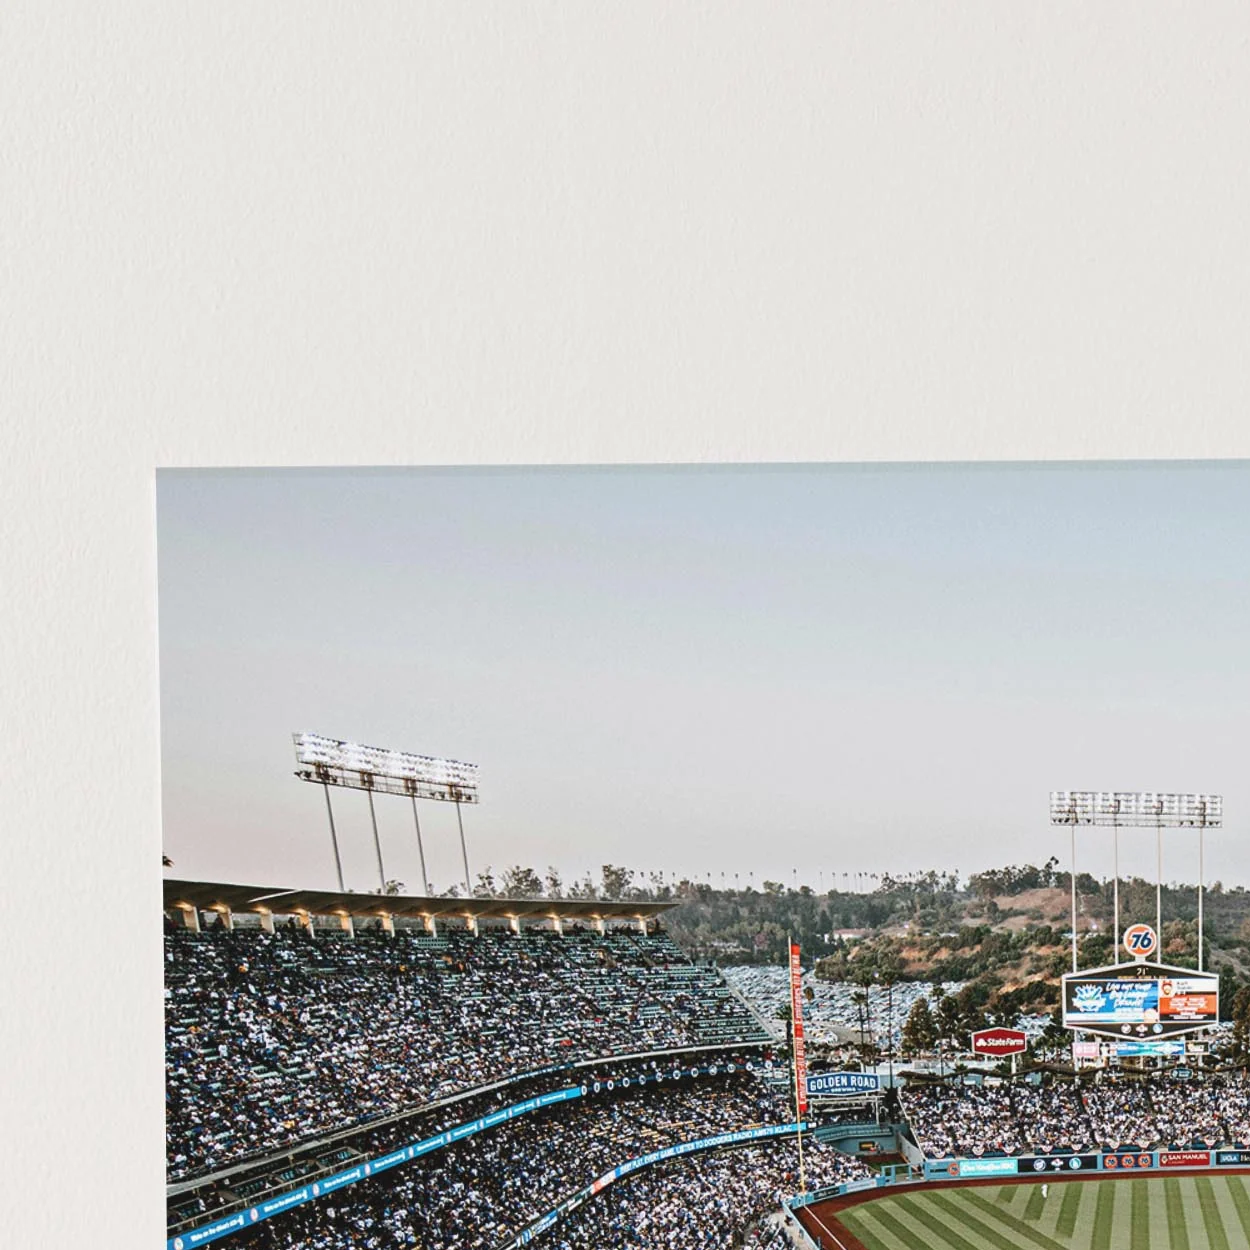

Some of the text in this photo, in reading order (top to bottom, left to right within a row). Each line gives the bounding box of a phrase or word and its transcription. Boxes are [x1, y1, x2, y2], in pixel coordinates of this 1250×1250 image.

[1130, 931, 1153, 949] 76
[810, 1075, 876, 1091] GOLDEN ROAD
